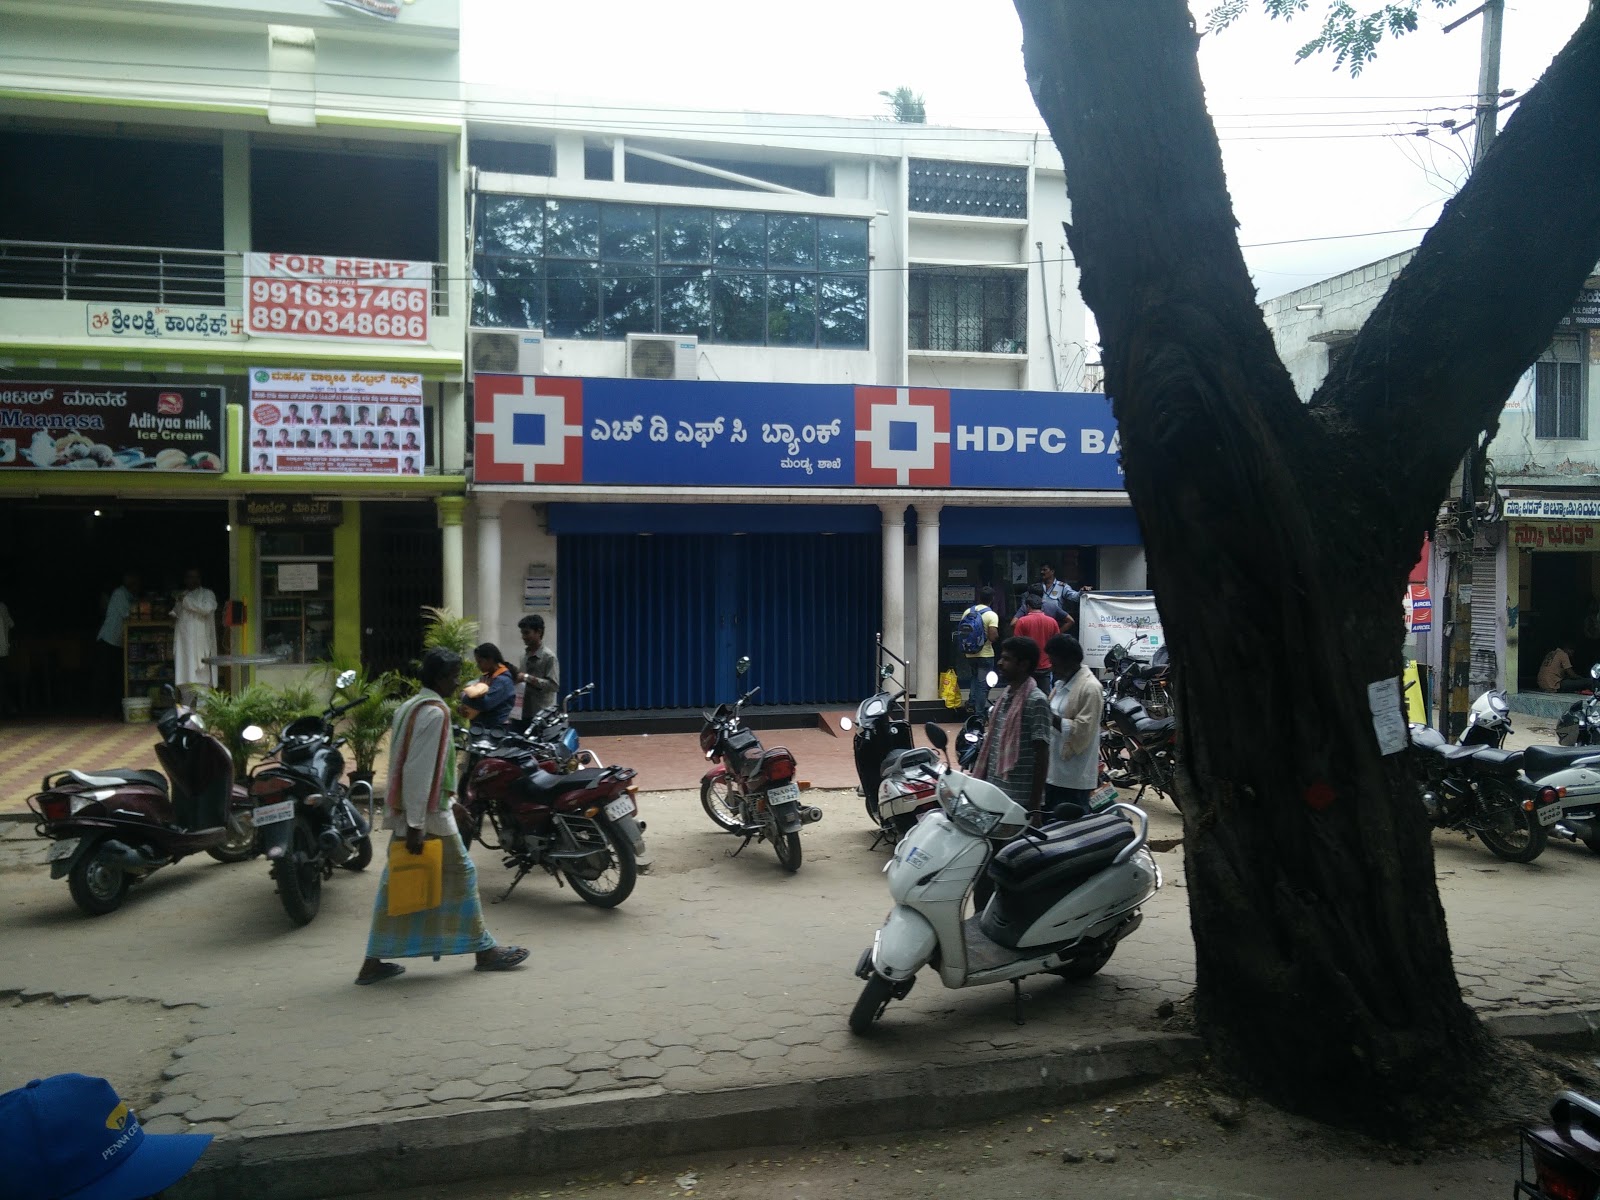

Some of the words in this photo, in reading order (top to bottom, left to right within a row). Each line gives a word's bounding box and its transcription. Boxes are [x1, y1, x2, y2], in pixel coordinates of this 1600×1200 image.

[269, 253, 325, 275] FOR
[335, 259, 409, 279] RENT
[252, 280, 424, 312] 9916337466
[252, 306, 424, 338] 8970348686
[62, 390, 128, 407] ಮಾನಸ
[0, 408, 104, 430] Maanasa
[129, 412, 181, 433] Adityaa
[184, 410, 211, 430] milk
[137, 430, 157, 440] Ice
[159, 430, 204, 441] Cream
[591, 415, 644, 443] ಎಚ್
[649, 415, 669, 443] ಡಿ
[674, 416, 726, 448] ಎಫ್
[730, 418, 747, 444] ಸಿ
[761, 418, 841, 456] ಬ್ಯಾಂಕ್
[956, 425, 1067, 454] HDFC
[780, 458, 813, 475] ಮಂಡ್ಯ
[817, 457, 842, 471] ಶಾಖೆ
[101, 1134, 131, 1161] PENNA
